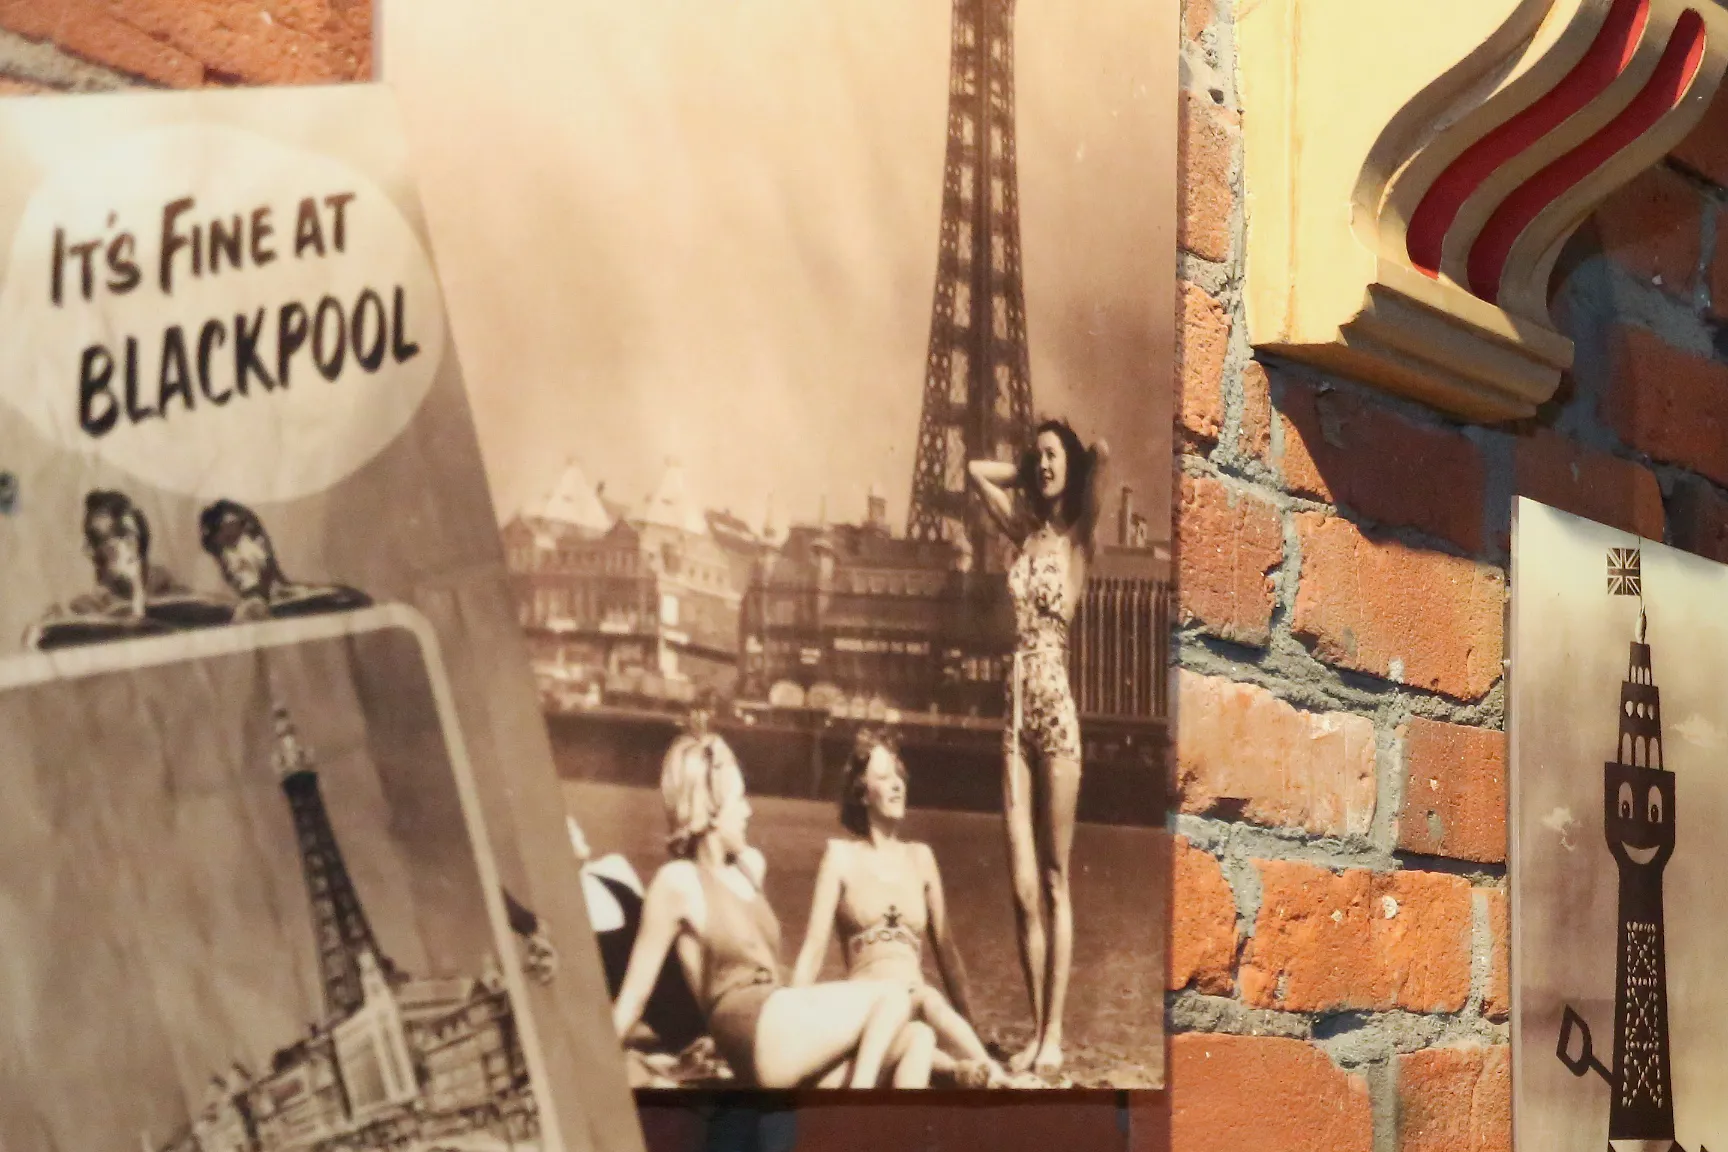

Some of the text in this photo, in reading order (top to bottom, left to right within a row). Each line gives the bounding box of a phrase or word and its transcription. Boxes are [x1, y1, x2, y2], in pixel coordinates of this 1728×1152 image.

[50, 192, 357, 307] IT'S FINE AT
[77, 285, 420, 438] BLACKPOOL
